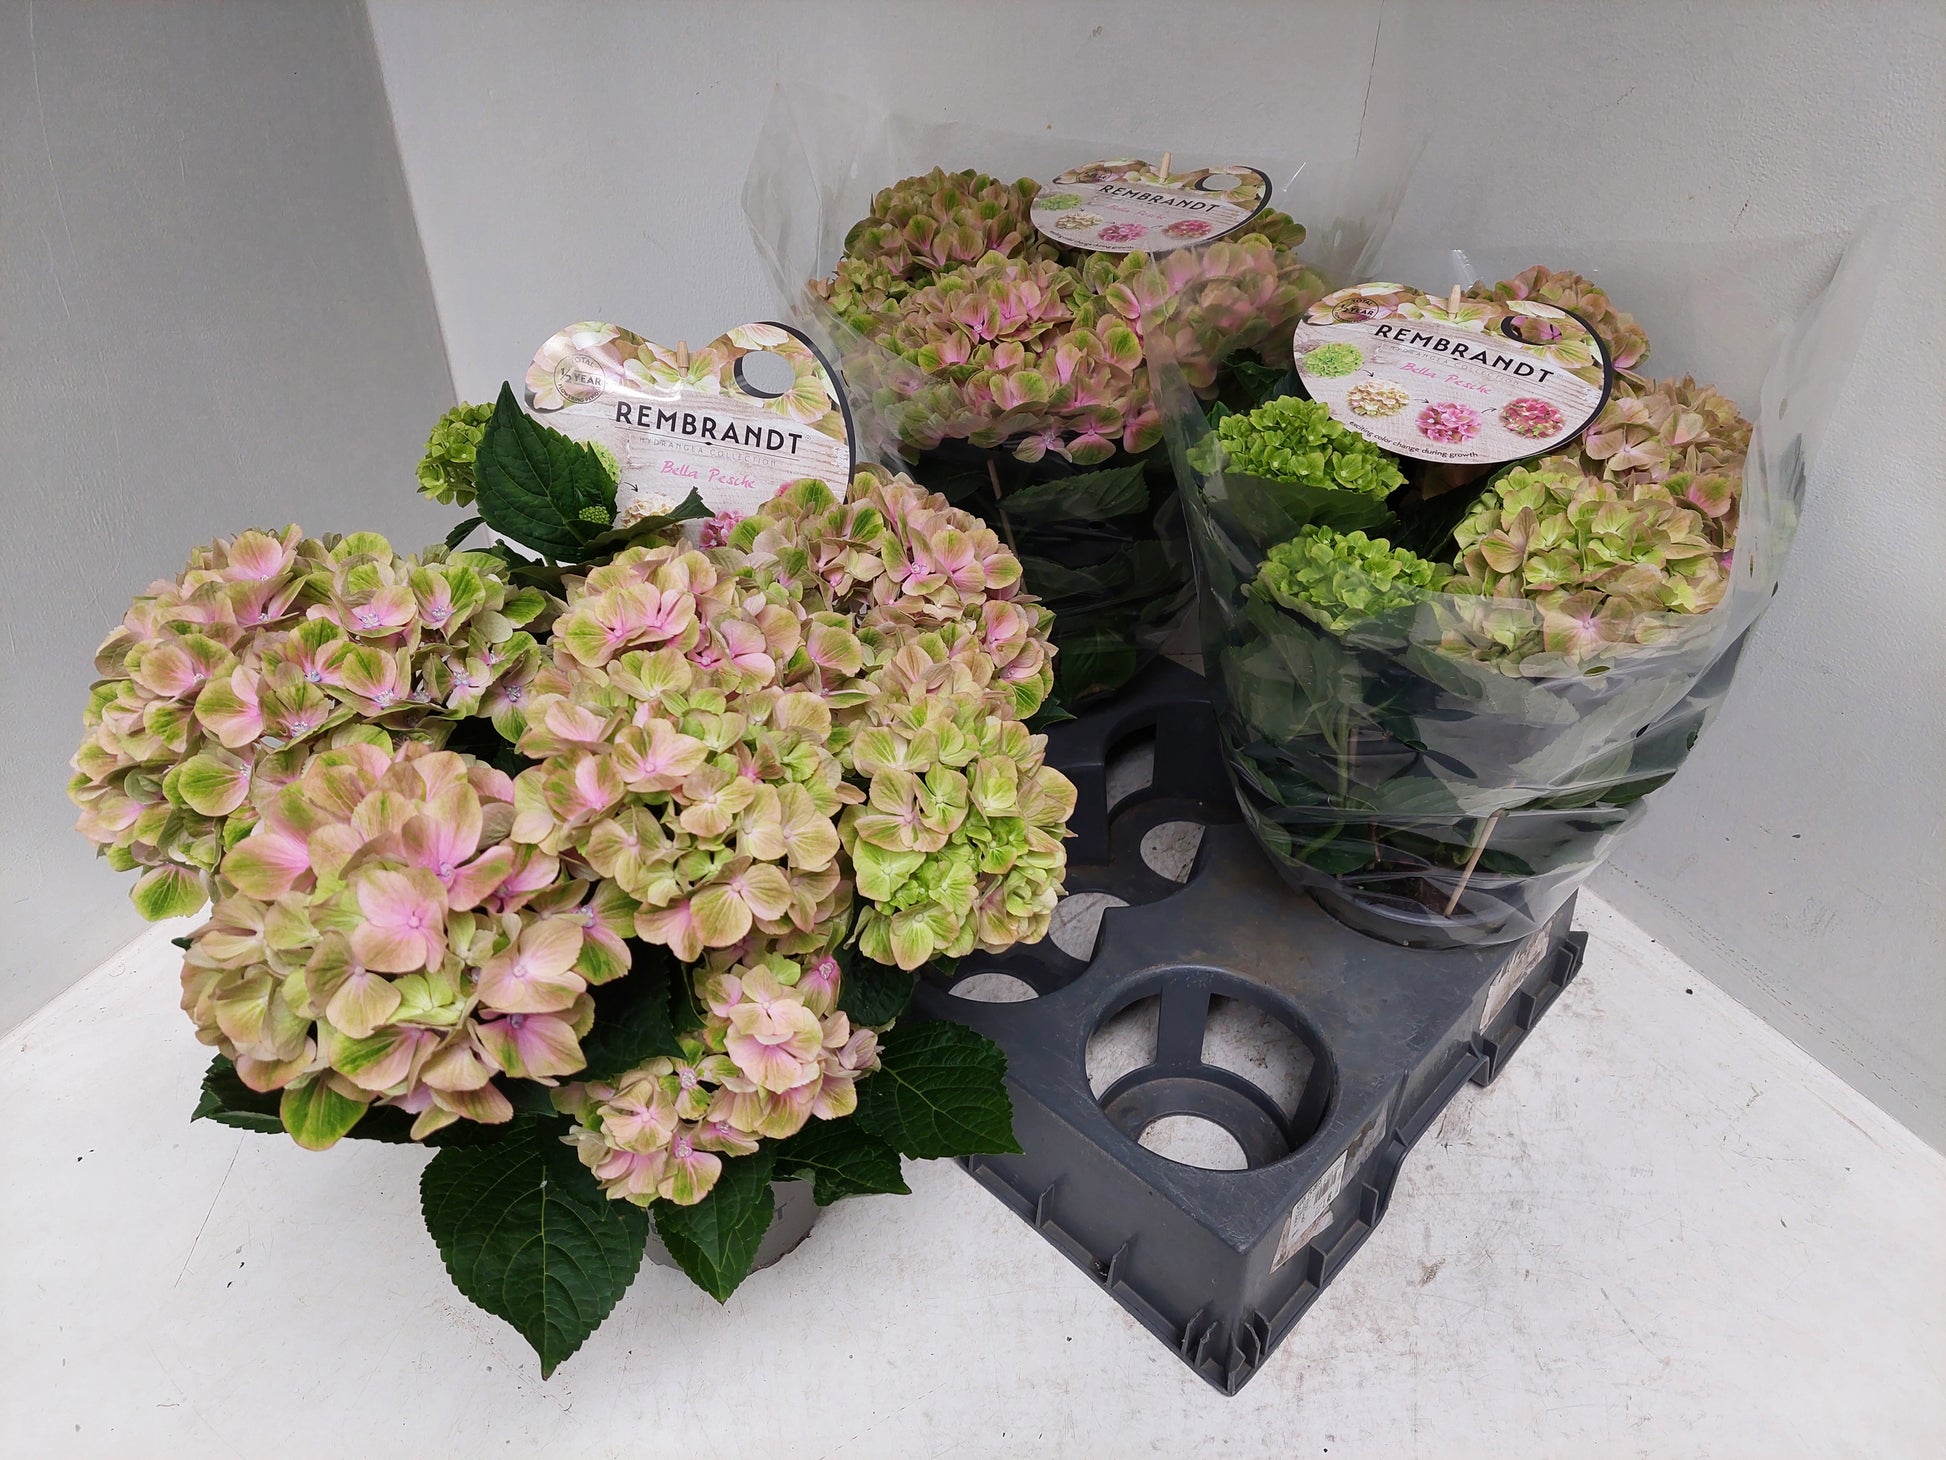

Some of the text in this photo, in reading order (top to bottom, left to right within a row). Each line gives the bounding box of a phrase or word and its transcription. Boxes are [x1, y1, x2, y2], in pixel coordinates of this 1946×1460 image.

[1098, 183, 1221, 214] REMBRANDT
[1374, 323, 1555, 384] REMBRANDT
[573, 372, 601, 386] YEAR
[1400, 361, 1493, 395] Bella Pesche
[615, 400, 803, 455] REMBRANDT
[1349, 420, 1479, 459] exciting color change during growth
[639, 437, 777, 467] HYDRANGEA COLLECTION
[660, 460, 757, 489] Bella Pesche
